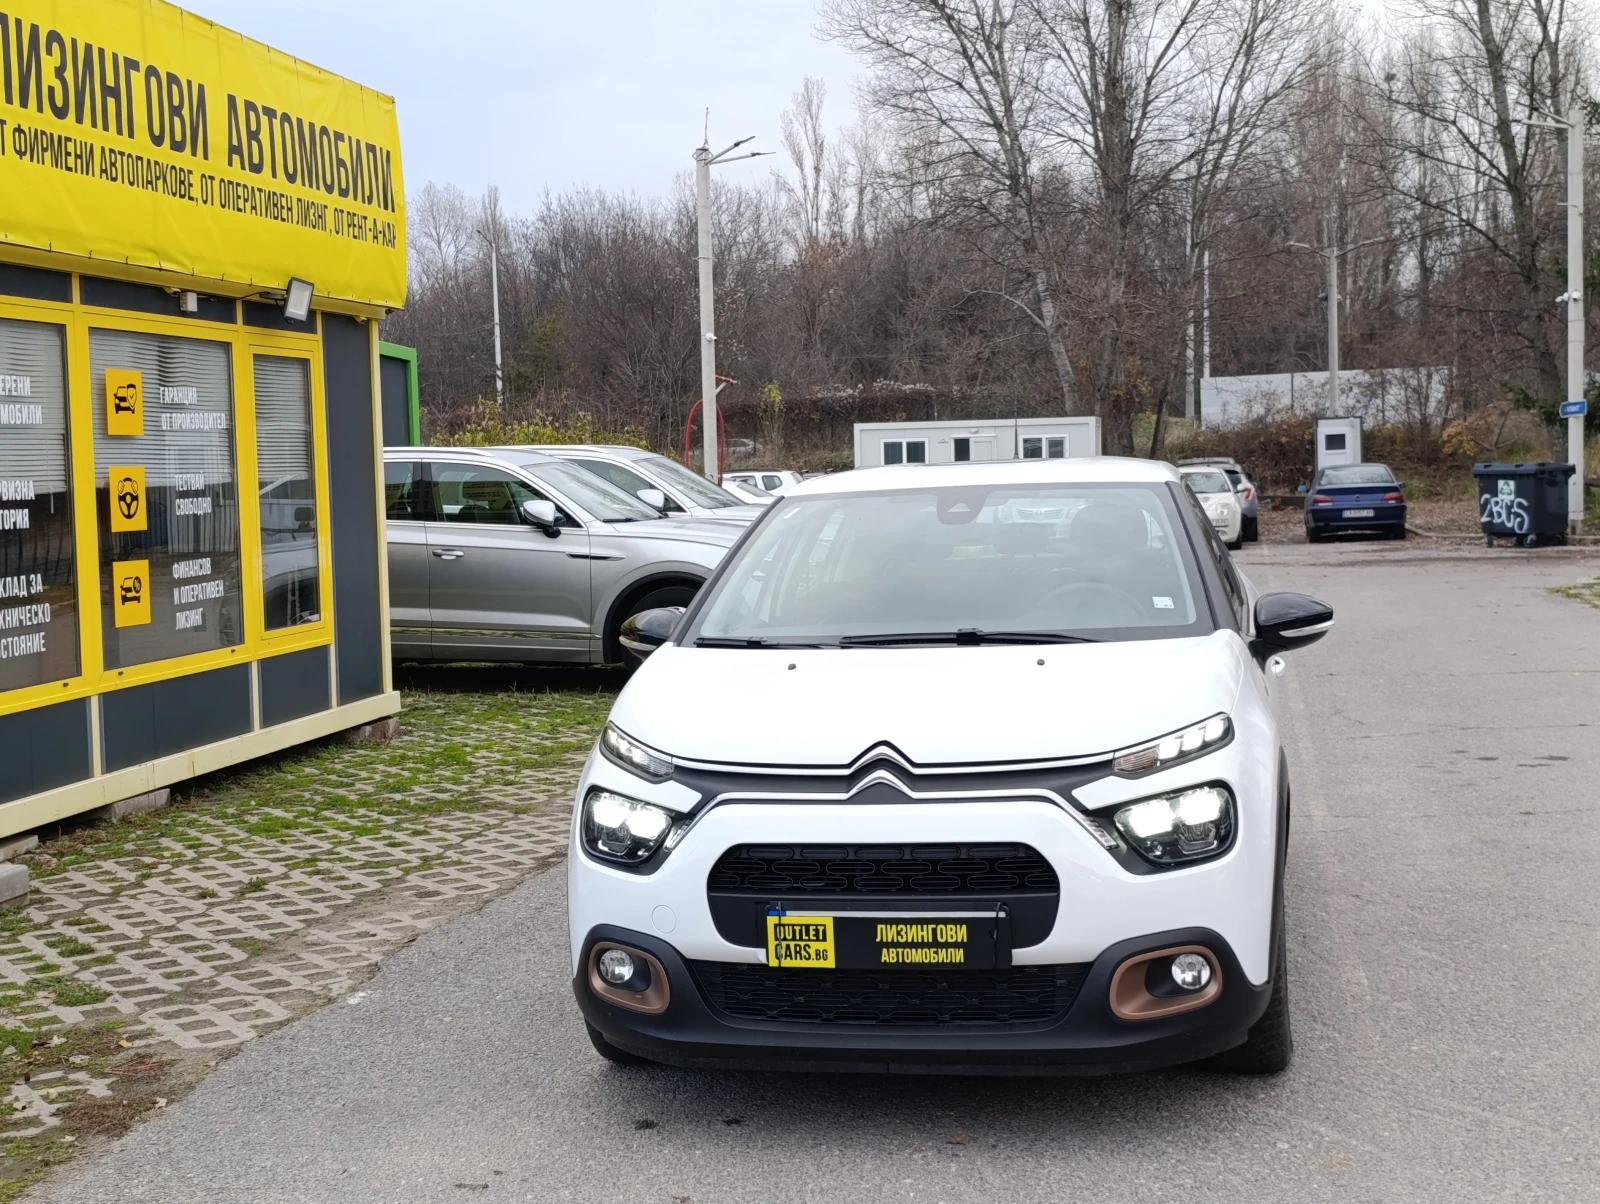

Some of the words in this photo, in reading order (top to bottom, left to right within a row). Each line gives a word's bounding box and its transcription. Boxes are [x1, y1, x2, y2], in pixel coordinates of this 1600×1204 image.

[227, 93, 396, 213] АВТОМОБИЛИ
[12, 123, 95, 177] ФИРМЕНИ
[100, 145, 198, 207] АВТОПАРКОВЕ,
[200, 173, 215, 207] ОТ
[219, 178, 294, 225] ОПЕРАТИВЕН
[334, 207, 345, 237] ОТ
[160, 387, 197, 405] ГАРАНЦИЯ
[0, 404, 42, 425] МОБИЛИ
[161, 413, 171, 430] ОТ
[172, 413, 226, 431] ПРОИЗВОДИТЕЛ
[0, 480, 35, 501] ВИЗНА
[175, 470, 205, 491] ТЕСТВАЙ
[176, 497, 212, 516] СВОБОДНО
[173, 557, 211, 580] ФИНАНСОВ
[30, 573, 43, 594] ЗА
[173, 587, 180, 605] И
[180, 580, 224, 604] ОПЕРАТИВЕН
[175, 607, 203, 631] ЛИЗИНГ
[0, 631, 46, 659] СТОЯНИЕ
[776, 925, 825, 940] OUTLET
[875, 924, 968, 943] ЛИЗИНГОВИ
[774, 943, 828, 961] CARS.BG
[880, 948, 965, 963] АВТОМОБИЛИ
